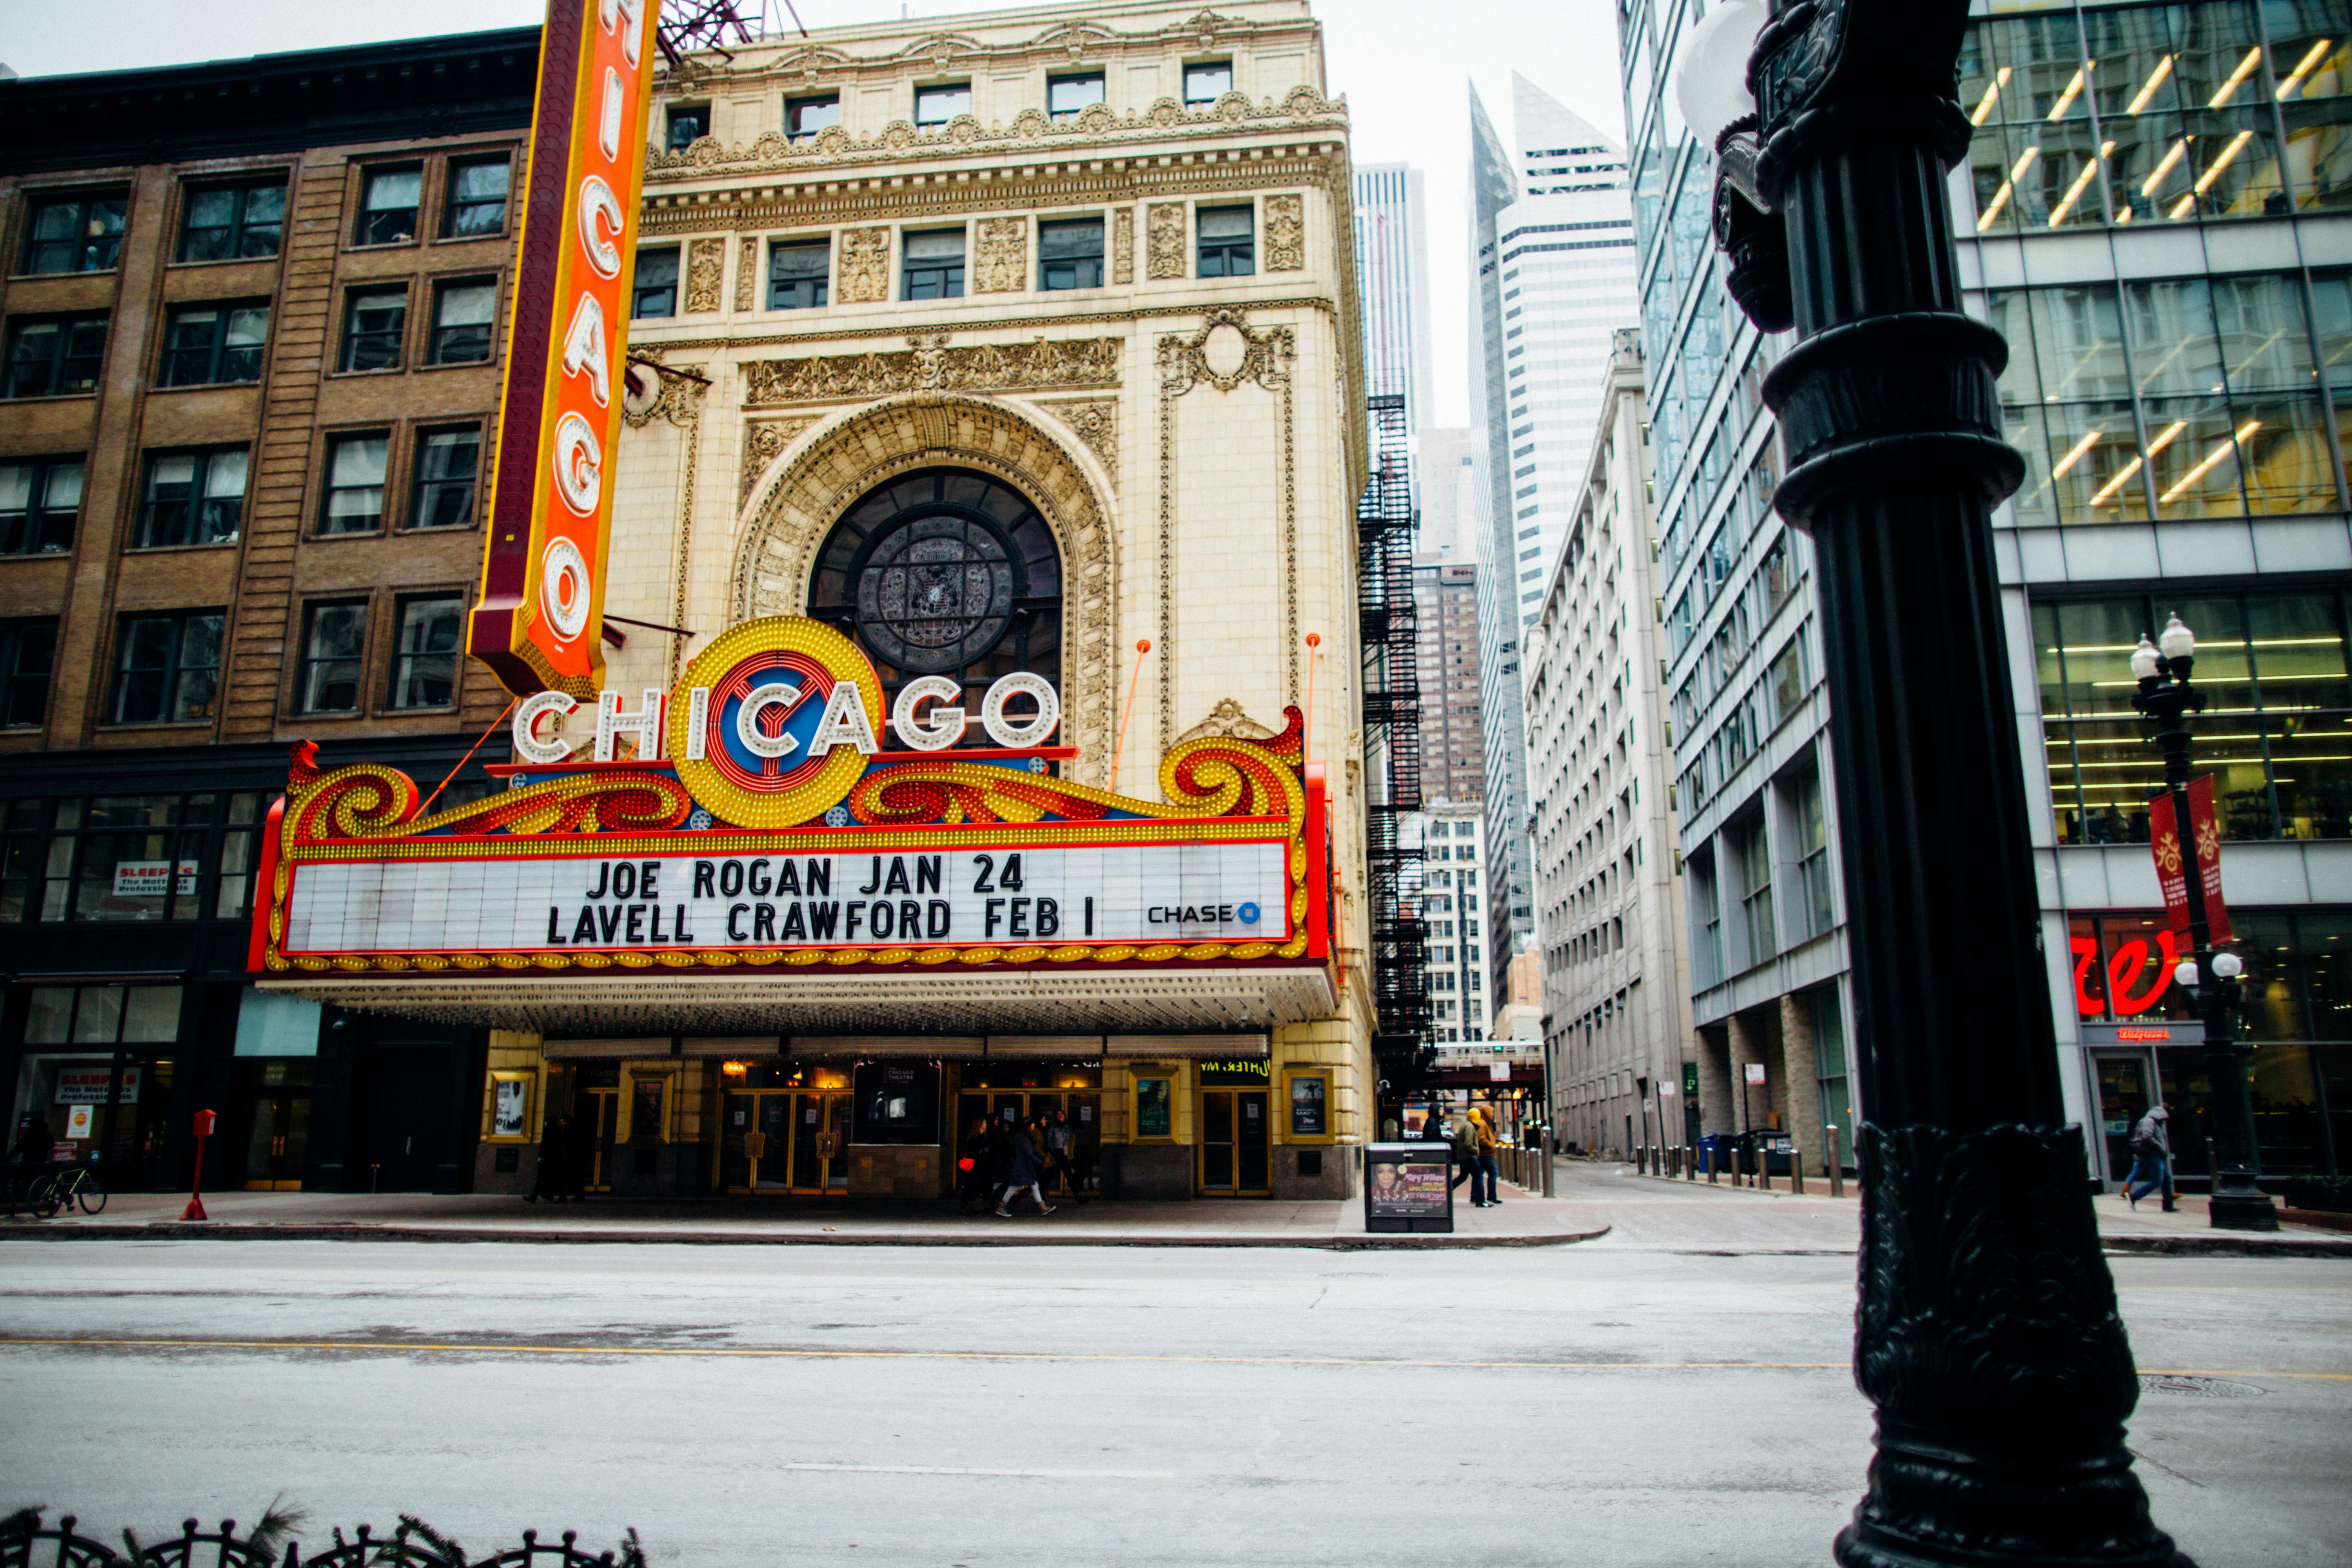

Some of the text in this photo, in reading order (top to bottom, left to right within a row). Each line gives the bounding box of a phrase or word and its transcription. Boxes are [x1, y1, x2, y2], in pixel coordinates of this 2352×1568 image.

[513, 671, 1060, 763] CHICAGO
[120, 866, 193, 877] SLEEP'S
[586, 853, 1023, 898] JOE ROGAN JAN 24
[547, 904, 693, 943] LAVELL
[728, 900, 950, 940] CRAWFORD
[985, 897, 1059, 938] FEB
[1148, 905, 1232, 923] CHASE
[2118, 1029, 2169, 1042] Walgreens
[62, 1073, 136, 1085] SLEEP'S
[1403, 1173, 1446, 1183] Mary Wilson
